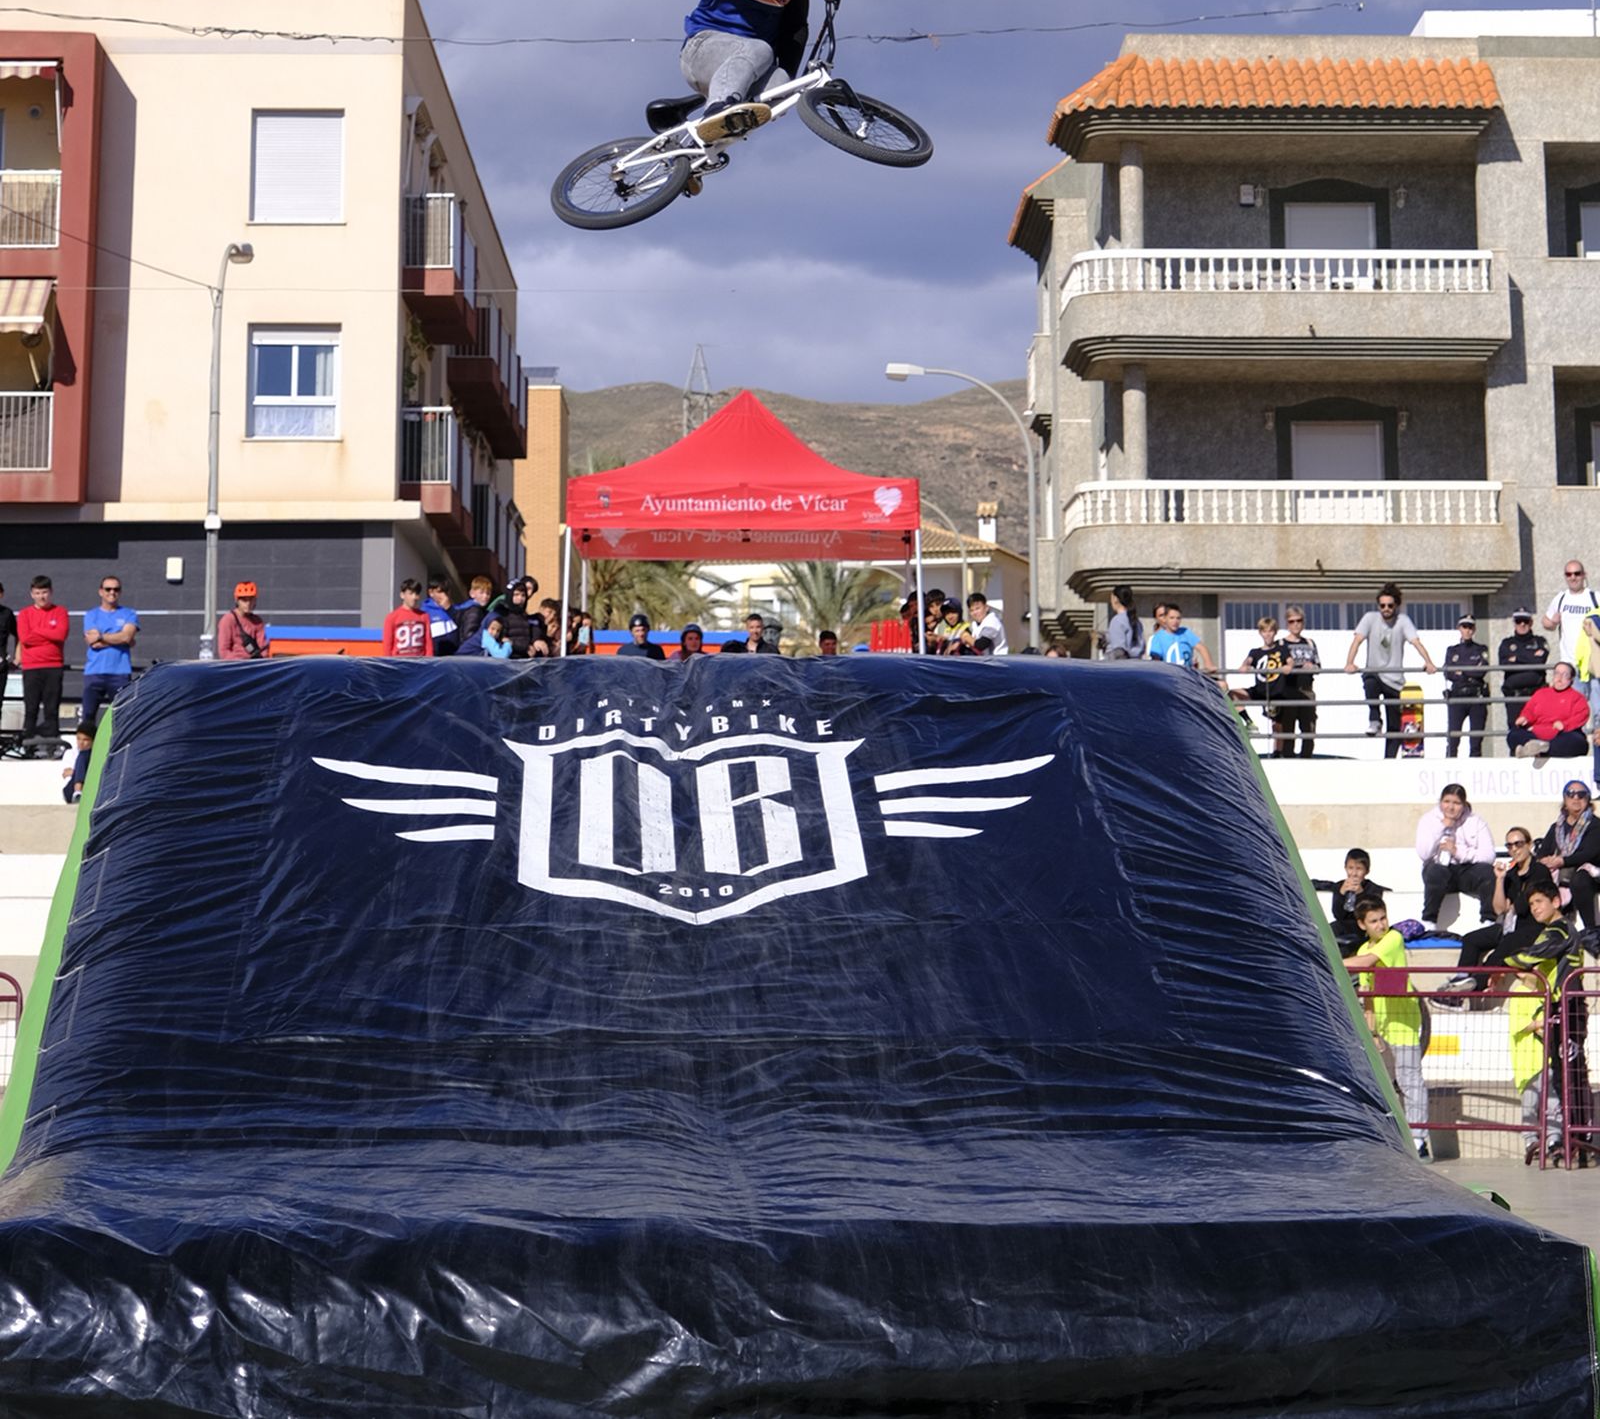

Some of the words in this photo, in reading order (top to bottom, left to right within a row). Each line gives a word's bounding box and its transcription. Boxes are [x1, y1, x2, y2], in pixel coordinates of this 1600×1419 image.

[640, 494, 766, 516] Ayuntamiento
[771, 494, 793, 512] de
[798, 494, 848, 512] Vícar
[396, 624, 424, 649] 92
[1472, 769, 1521, 796] HACE
[1530, 769, 1594, 796] LLO
[658, 883, 734, 898] 2010
